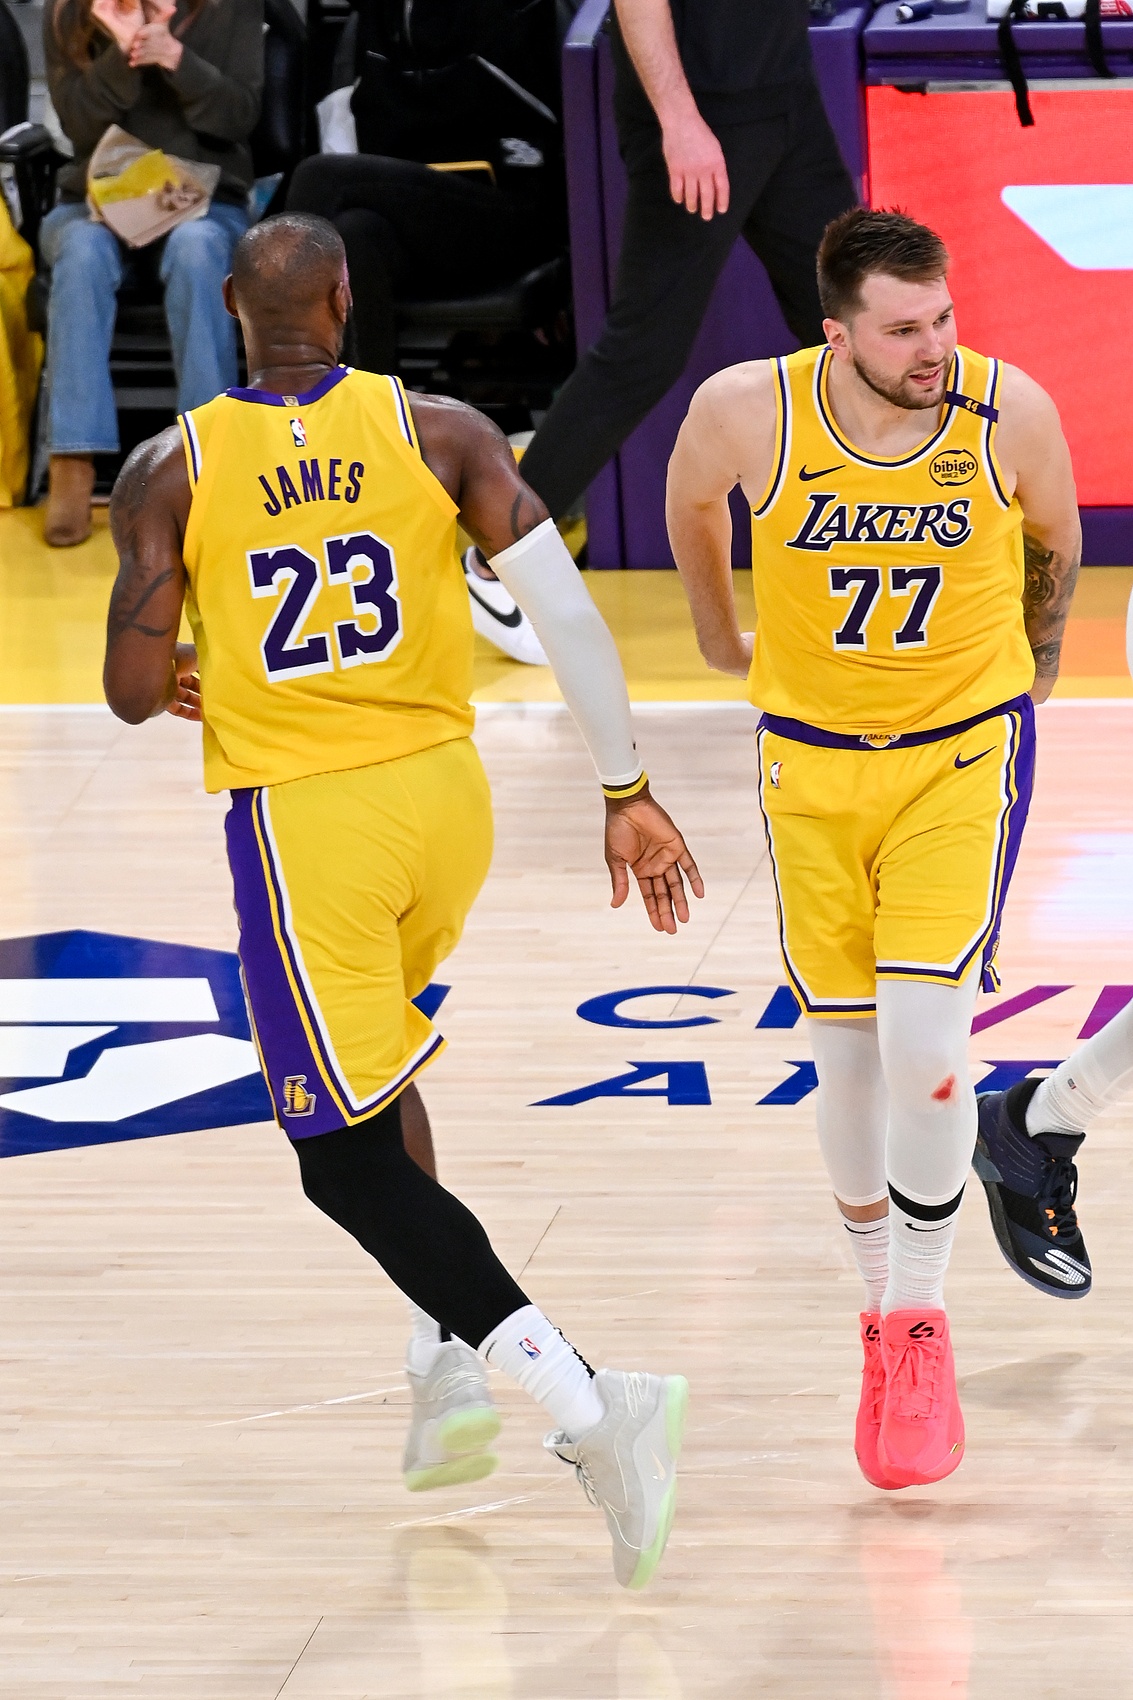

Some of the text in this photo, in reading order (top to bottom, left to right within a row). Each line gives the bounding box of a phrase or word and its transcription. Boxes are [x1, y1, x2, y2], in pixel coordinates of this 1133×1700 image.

[965, 399, 979, 412] 44
[258, 458, 365, 517] JAMES
[933, 459, 975, 475] bibigo
[785, 493, 974, 552] LAKERS
[246, 530, 404, 684] 23
[828, 565, 944, 652] 77
